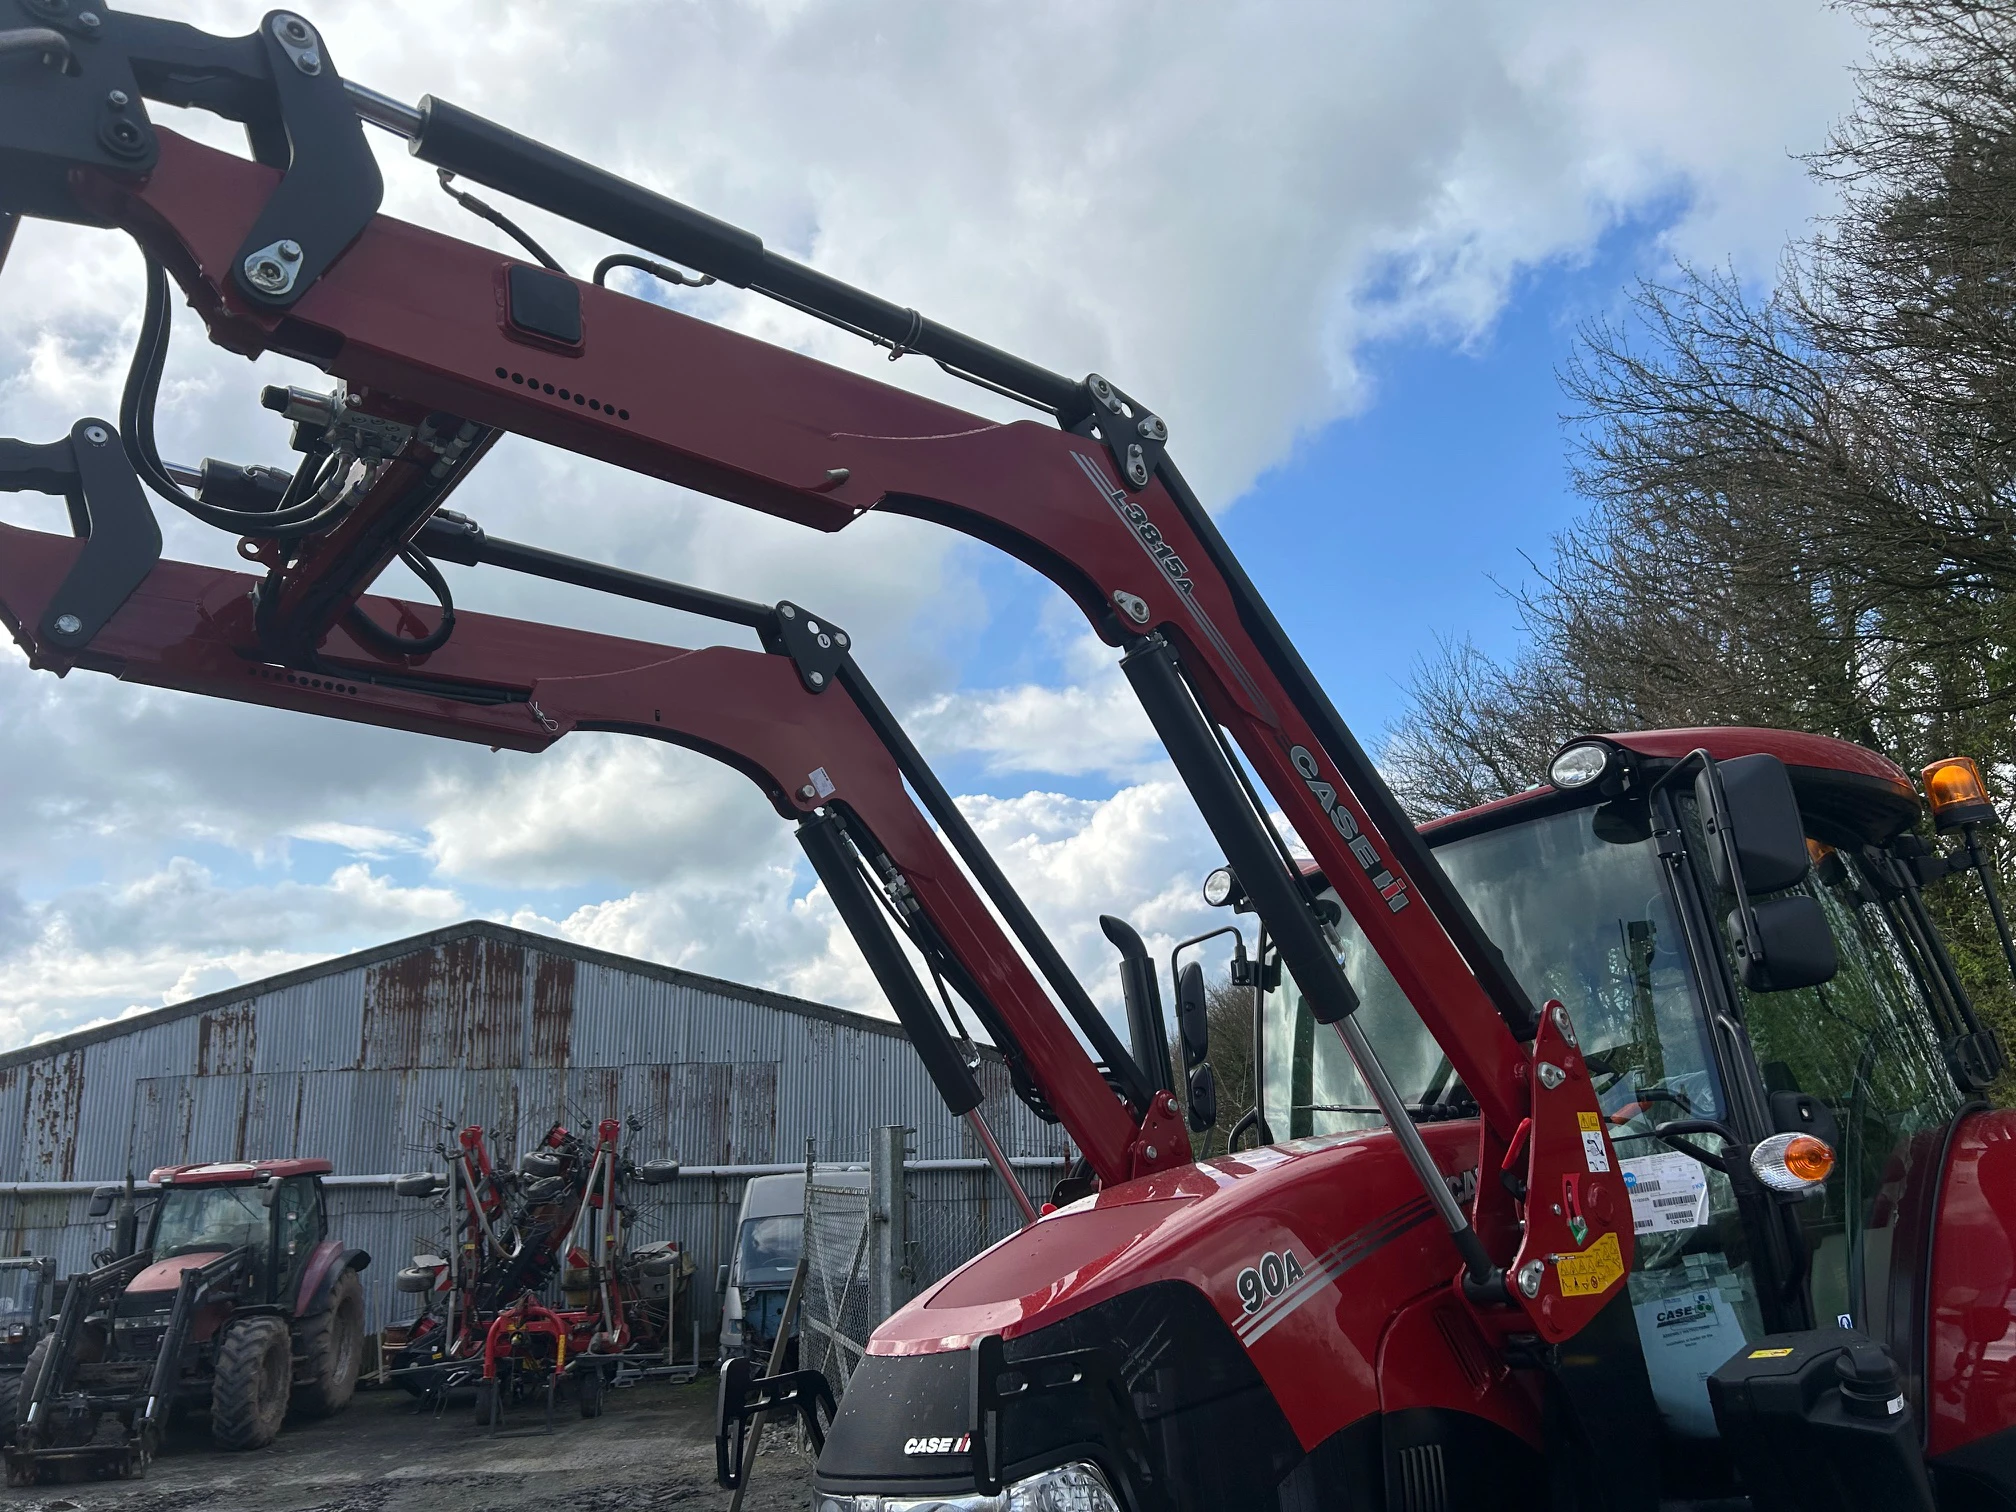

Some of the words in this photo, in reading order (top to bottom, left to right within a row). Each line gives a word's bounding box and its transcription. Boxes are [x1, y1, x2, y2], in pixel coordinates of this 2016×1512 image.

[1111, 489, 1194, 595] L3815A
[1290, 745, 1381, 870] CASE
[1236, 1248, 1306, 1315] 90A
[1656, 1306, 1692, 1322] CASE
[904, 1437, 953, 1455] CASE
